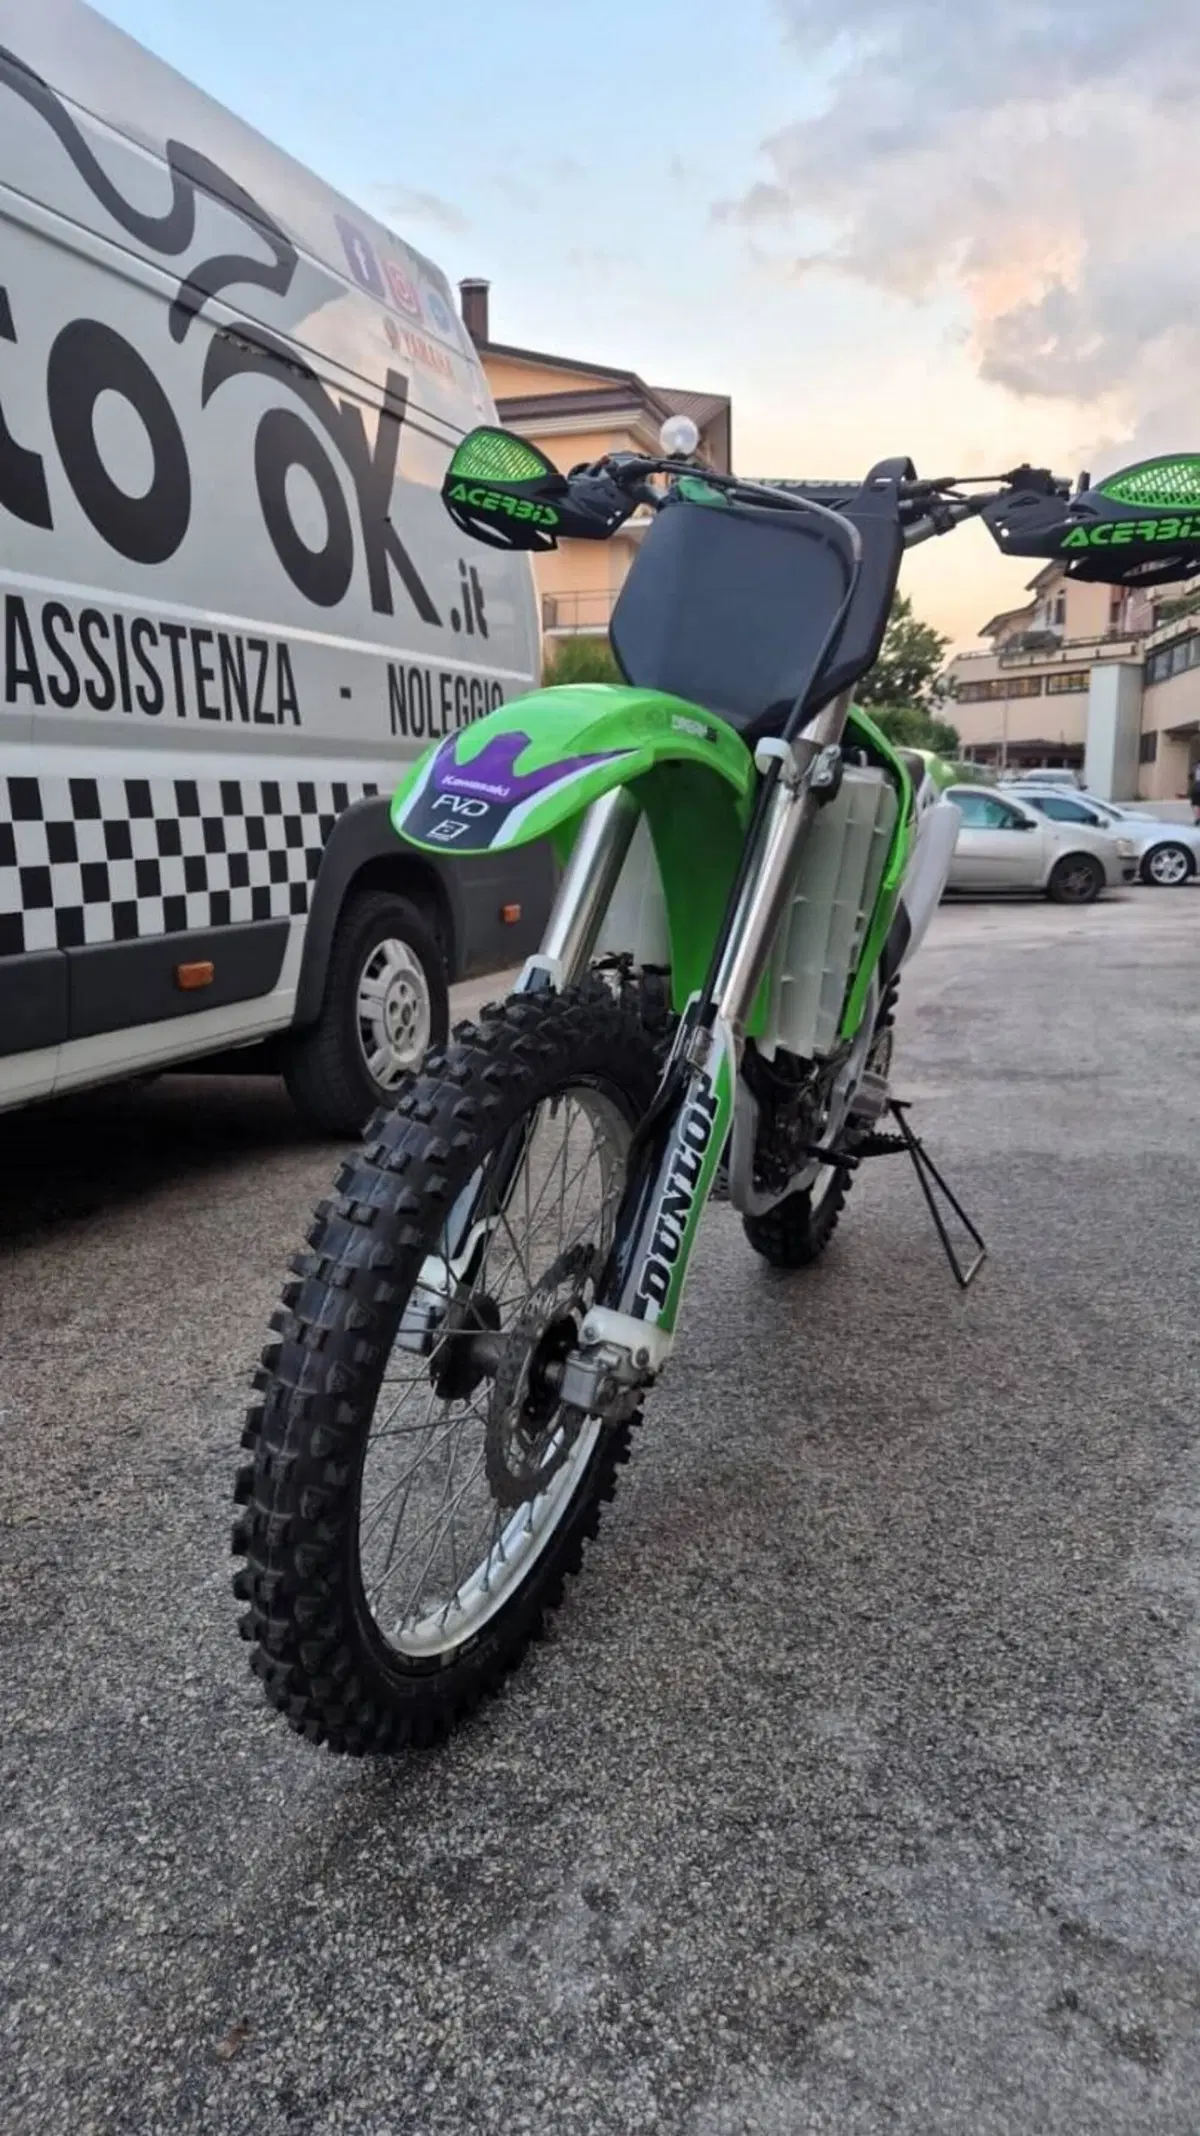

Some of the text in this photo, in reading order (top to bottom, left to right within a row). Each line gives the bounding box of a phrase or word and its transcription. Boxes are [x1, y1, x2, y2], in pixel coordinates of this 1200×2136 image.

[5, 593, 301, 726] ASSISTENZA
[441, 774, 511, 797] Kawasaki
[638, 1070, 721, 1313] DUNLOP
